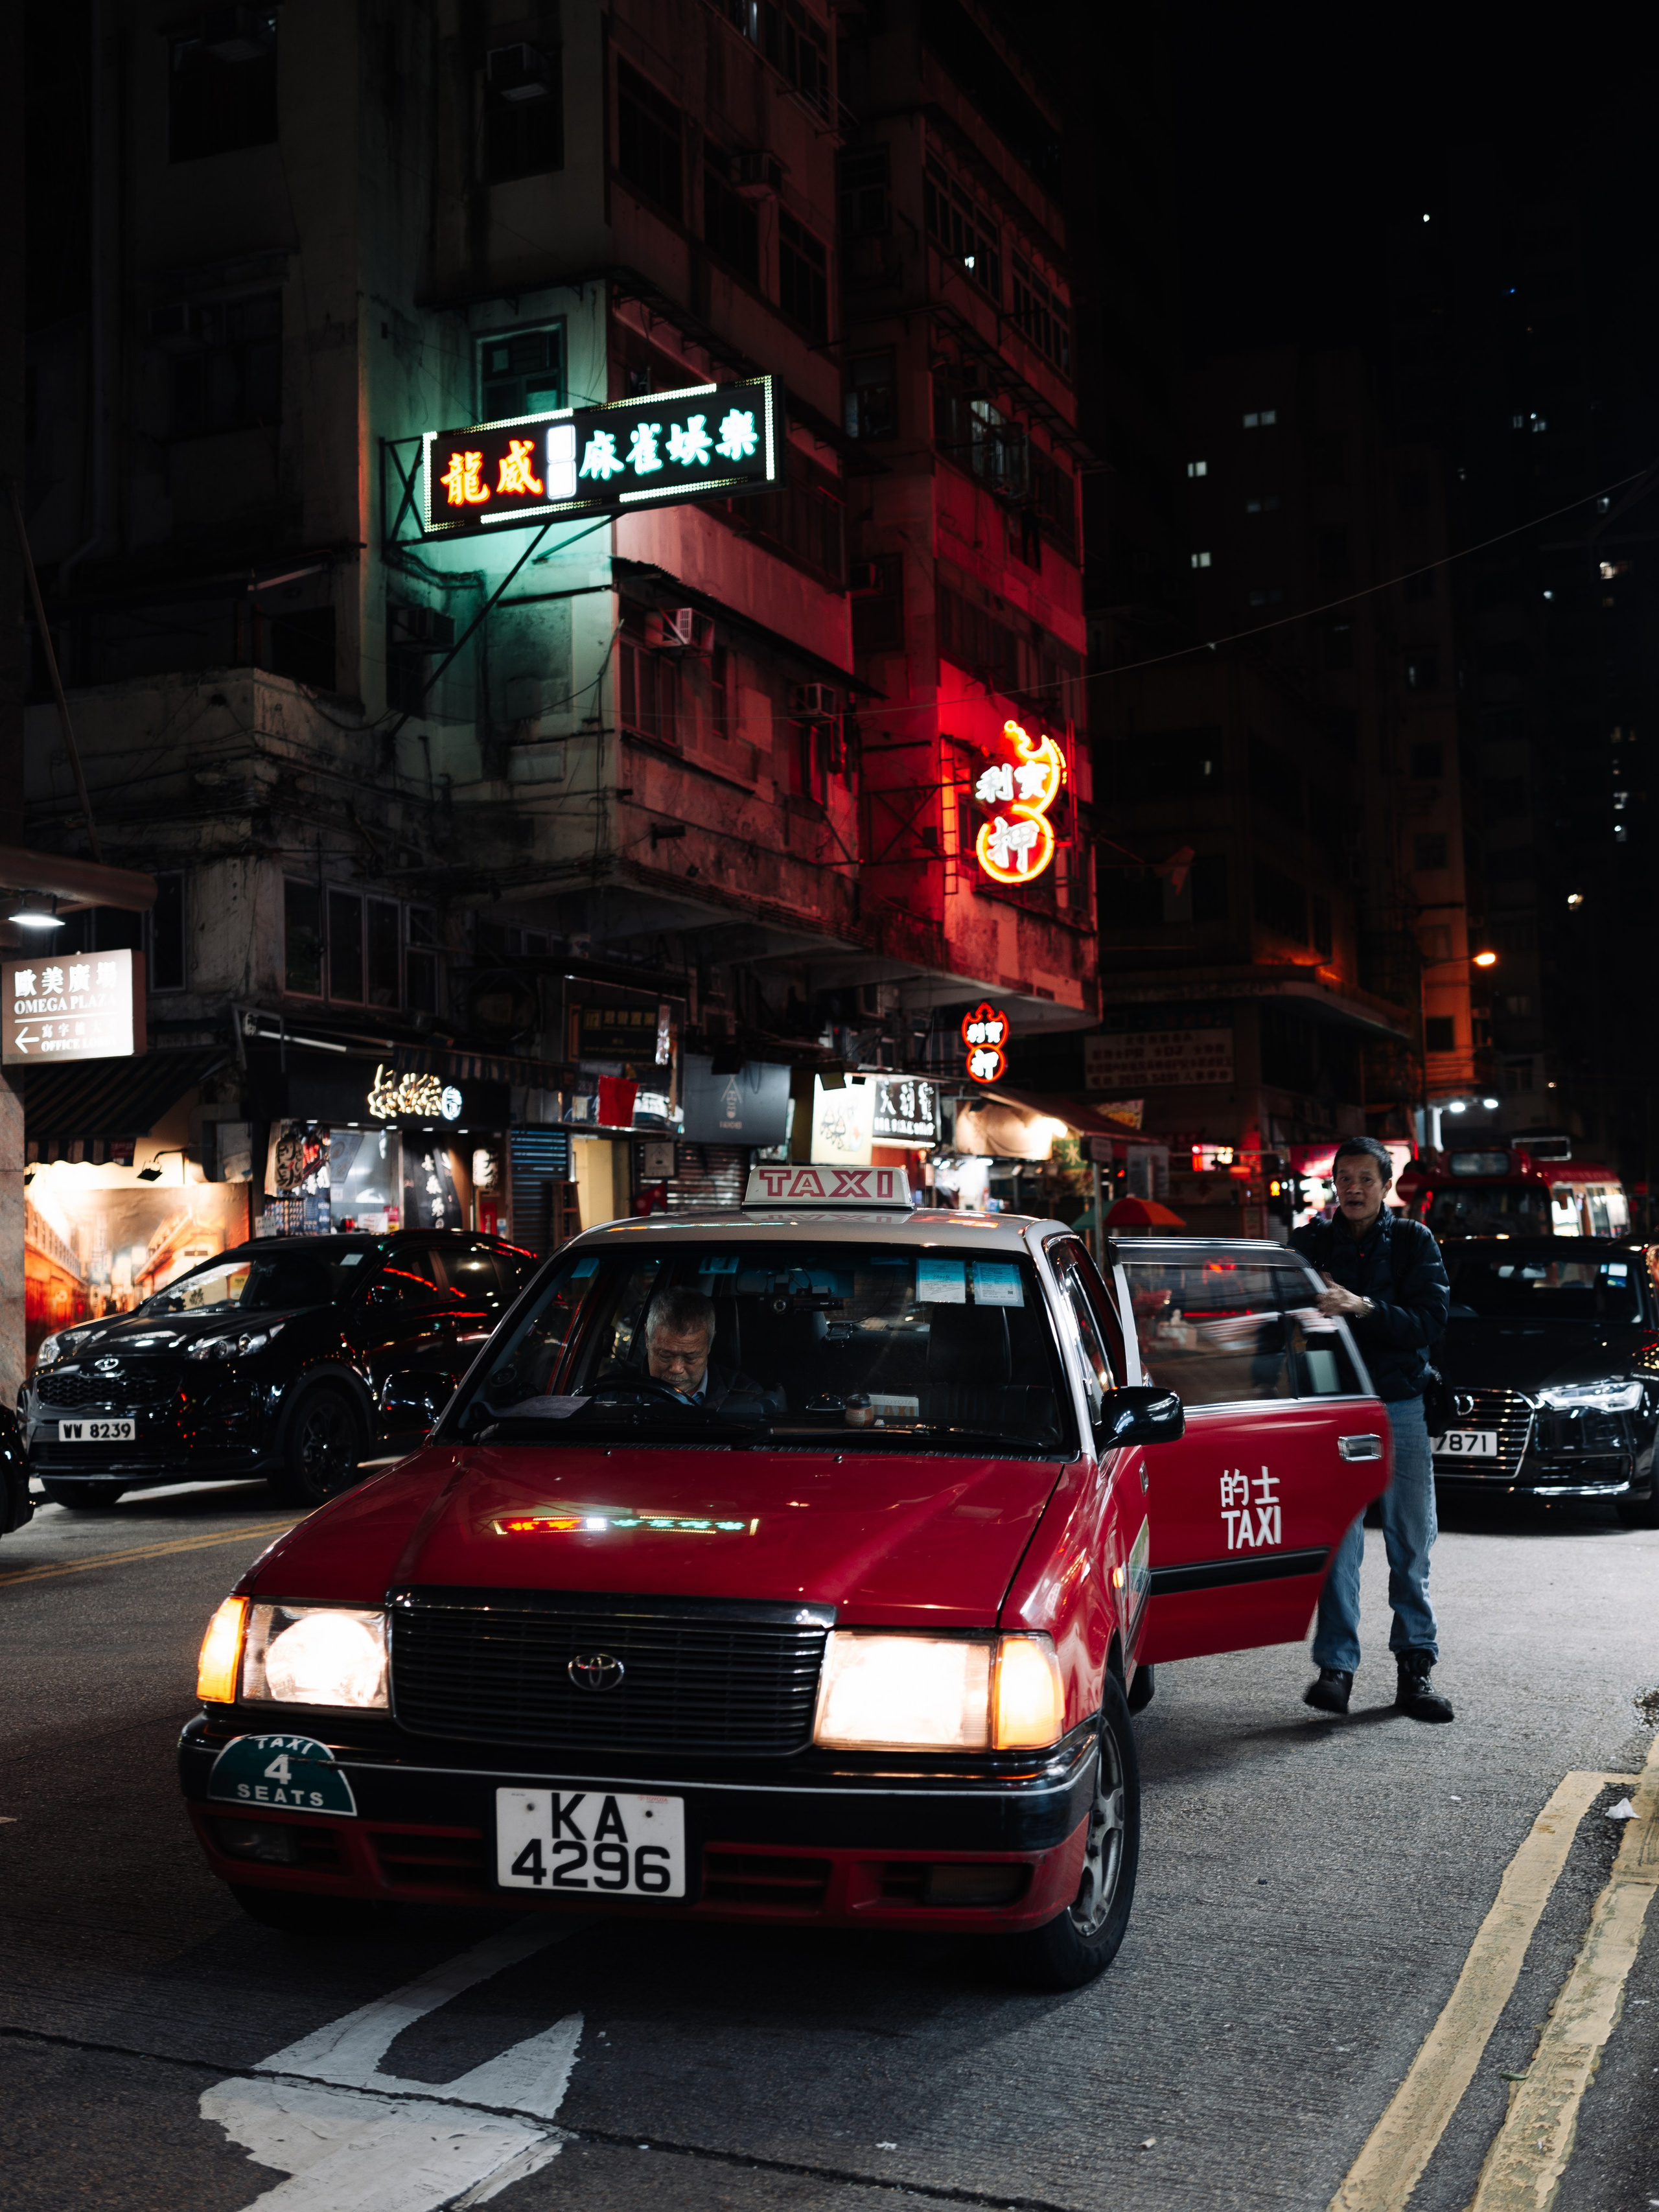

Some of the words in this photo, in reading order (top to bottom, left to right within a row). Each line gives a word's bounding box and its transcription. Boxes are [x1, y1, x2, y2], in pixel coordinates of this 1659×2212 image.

[441, 439, 544, 507] 龍威
[579, 408, 760, 481] 麻雀娛樂
[14, 961, 117, 997] 歐美廣場
[14, 997, 67, 1015] OMEGA
[70, 993, 117, 1010] PLAZA
[41, 1038, 80, 1053] OFFICE
[759, 1169, 893, 1198] TAXI
[63, 1423, 83, 1439] WW
[89, 1423, 132, 1439] 8239
[1436, 1434, 1487, 1452] 7871
[1220, 1465, 1281, 1508] 的士
[1220, 1505, 1282, 1550] TAXI
[255, 1737, 314, 1754] TAXI
[264, 1754, 292, 1785] 4
[237, 1783, 324, 1807] SEATS
[551, 1792, 629, 1843] KA
[511, 1838, 671, 1893] 4296
